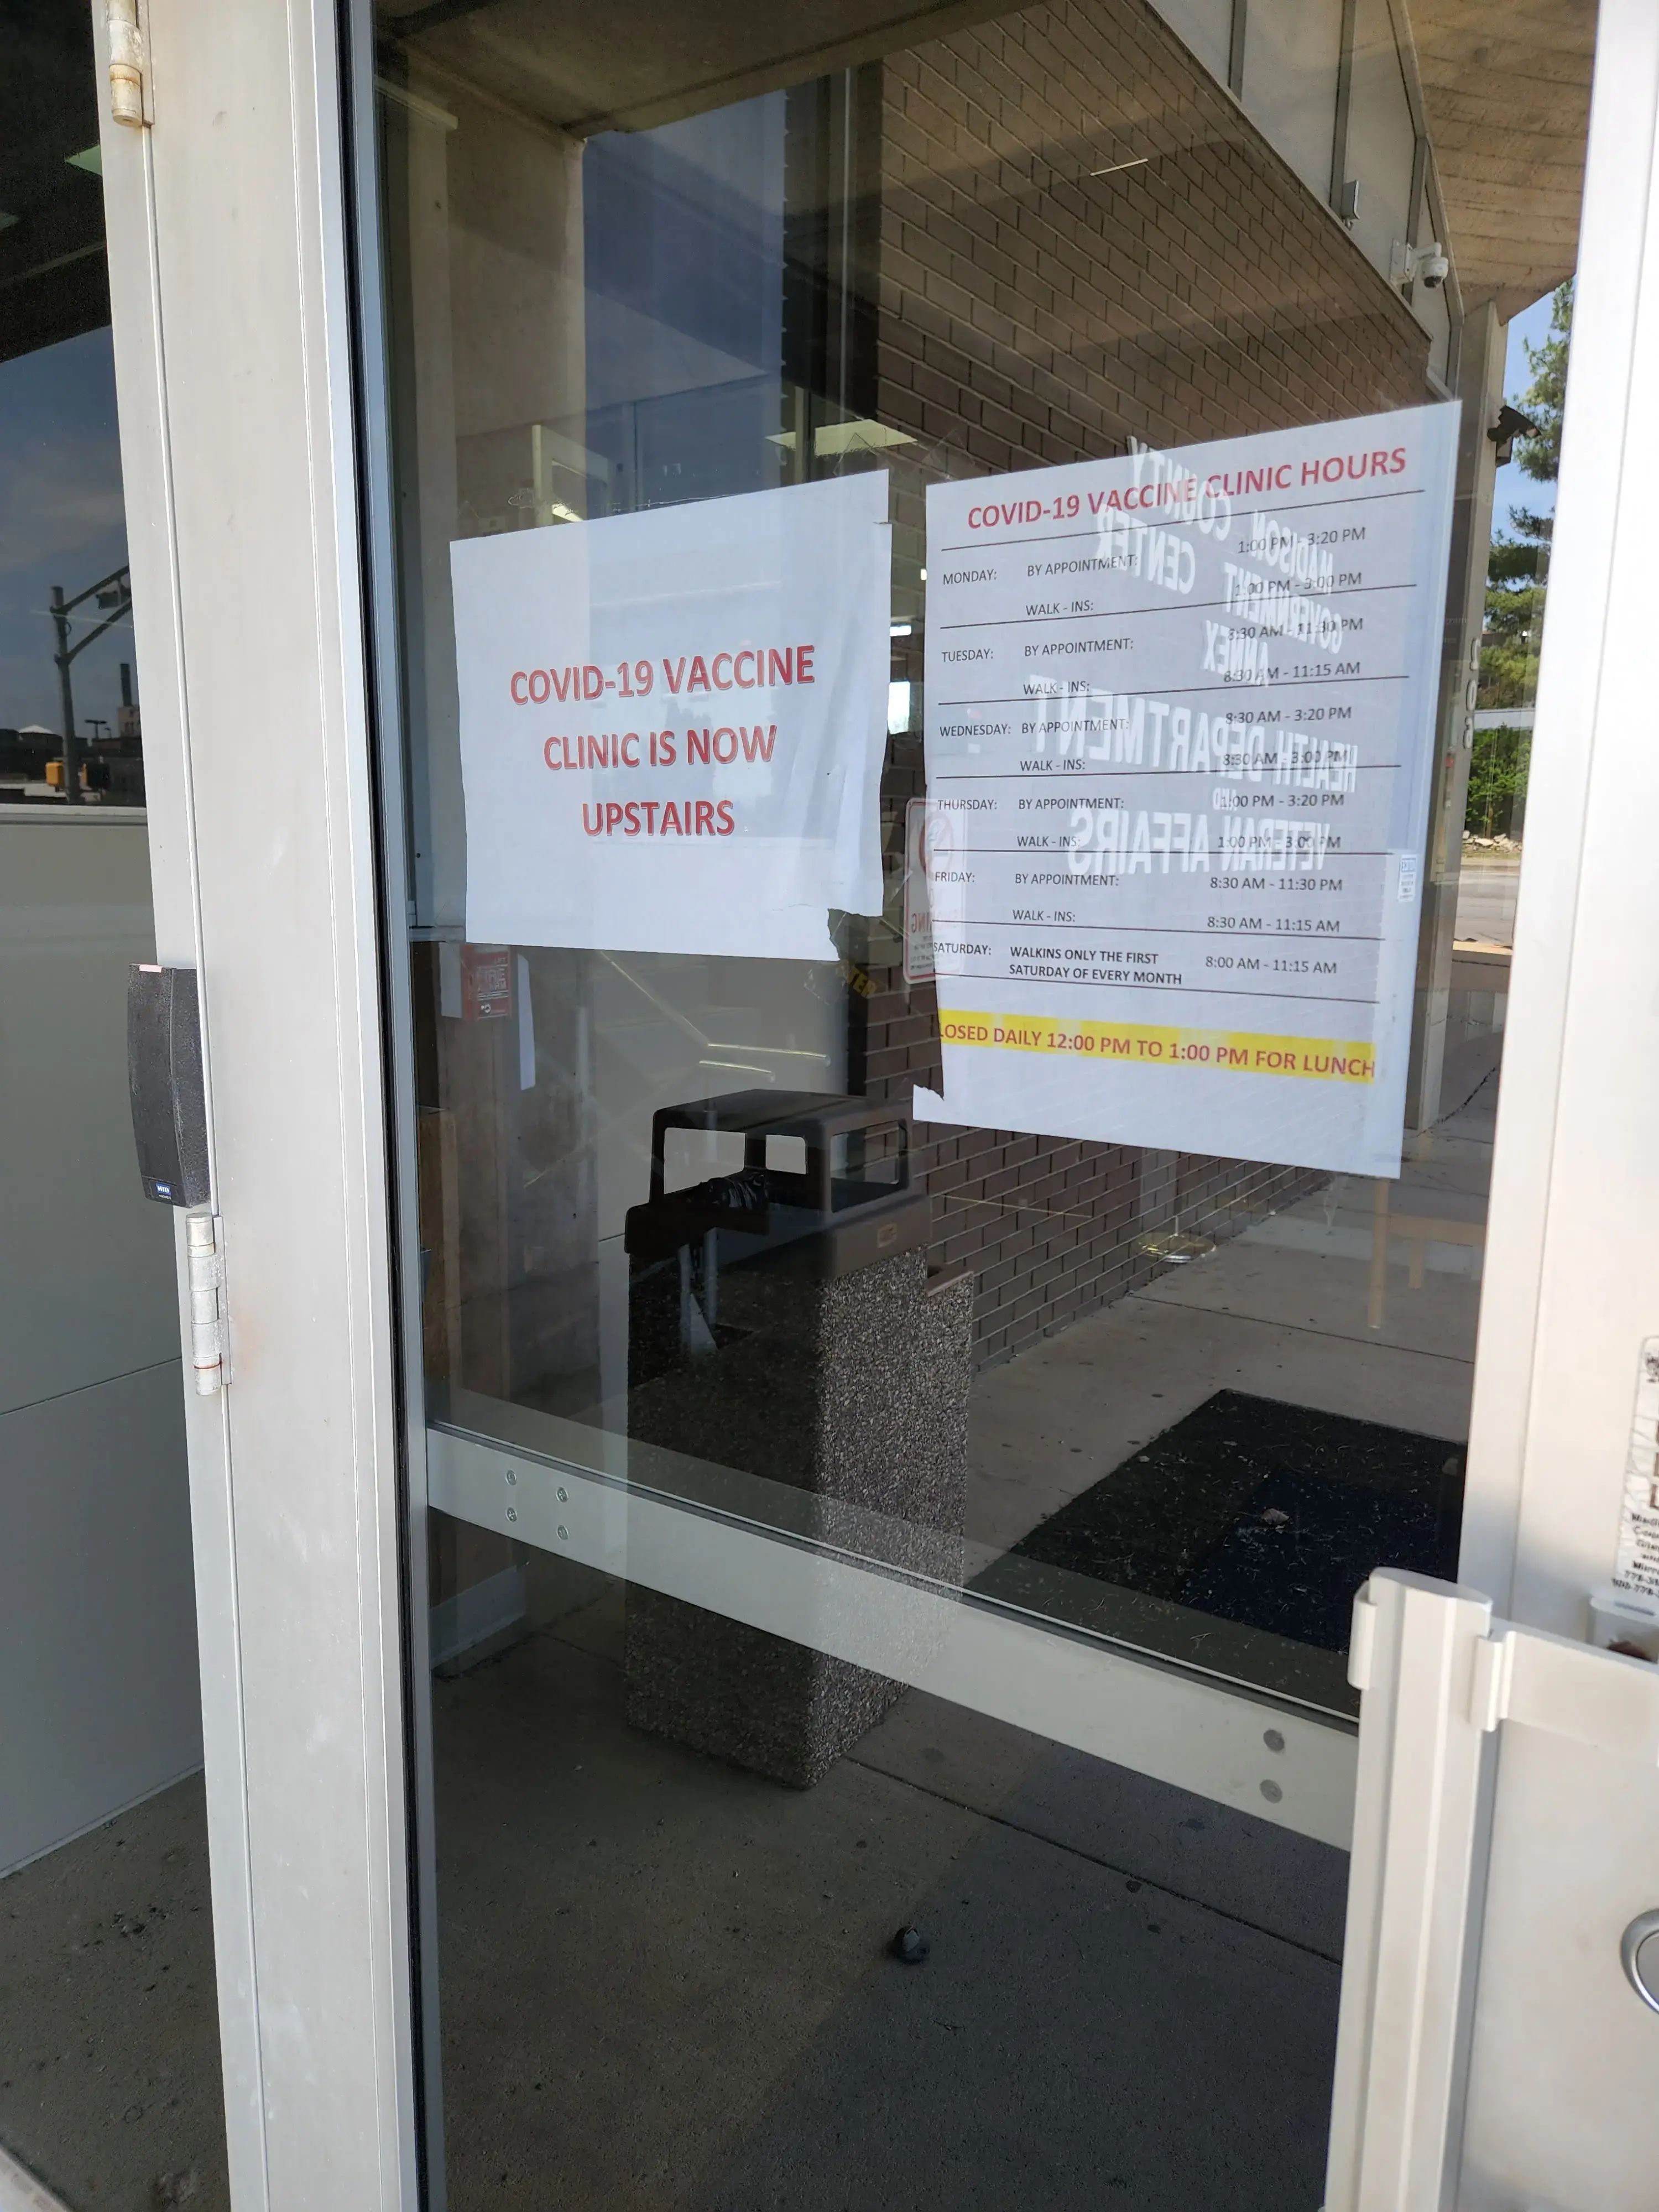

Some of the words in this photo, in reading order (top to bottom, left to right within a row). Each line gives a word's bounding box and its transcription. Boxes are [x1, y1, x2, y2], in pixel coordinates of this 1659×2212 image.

[968, 494, 1080, 529] COVID-19
[1087, 477, 1196, 514] VACCINE
[1205, 465, 1291, 498] CLINIC
[1301, 447, 1406, 486] HOURS
[943, 569, 997, 585] MONDAY:
[1027, 564, 1042, 577] BY
[1045, 554, 1138, 576] APPOINTMENT:
[1239, 538, 1266, 554] 1:00
[1271, 535, 1293, 551] PM
[1307, 531, 1338, 546] 3:20
[1343, 526, 1366, 542] PM
[1026, 602, 1060, 615] WALK
[1071, 600, 1094, 613] INS:
[1269, 580, 1290, 593] PM
[1305, 575, 1334, 591] 3:00
[1339, 572, 1362, 587] PM
[941, 648, 994, 662] TUESDAY:
[1025, 644, 1040, 656] BY
[1042, 638, 1134, 655] APPOINTMENT:
[1259, 624, 1283, 638] AM
[1341, 618, 1363, 632] PM
[510, 659, 654, 705] COVID-19
[662, 645, 815, 694] VACCINE
[1023, 682, 1057, 696] WALK
[1067, 681, 1090, 693] INS:
[1293, 664, 1331, 678] 11:15
[1335, 662, 1360, 675] AM
[940, 723, 1011, 737] WEDNESDAY:
[1021, 722, 1036, 734] BY
[1039, 719, 1130, 733] APPOINTMENT:
[1225, 712, 1254, 724] 8:30
[1257, 709, 1281, 722] AM
[1295, 708, 1325, 722] 3:20
[1329, 706, 1352, 719] PM
[543, 732, 640, 770] CLINIC
[650, 731, 676, 766] IS
[687, 724, 778, 765] NOW
[1020, 759, 1053, 771] WALK
[1063, 759, 1086, 770] INS:
[1223, 753, 1250, 766] 8:30
[1253, 752, 1277, 765] AM
[582, 799, 735, 837] UPSTAIRS
[937, 799, 998, 811] THURSDAY:
[1019, 799, 1033, 809] BY
[1035, 797, 1124, 809] APPOINTMENT:
[1219, 795, 1248, 808] 1:00
[1252, 795, 1274, 807] PM
[1287, 794, 1318, 806] 3:20
[1323, 794, 1345, 806] PM
[1017, 836, 1048, 847] WALK
[935, 872, 975, 883] FRIDAY:
[1015, 873, 1029, 885] BY
[1031, 874, 1119, 886] APPOINTMENT:
[1210, 877, 1239, 889] 8:30
[1241, 877, 1265, 890] AM
[1279, 878, 1316, 891] 11:30
[1319, 879, 1343, 891] PM
[1013, 909, 1044, 922] WALK
[1054, 910, 1076, 922] INS:
[1207, 917, 1236, 929] 8:30
[1239, 917, 1262, 930] AM
[1276, 919, 1312, 932] 11:15
[1316, 920, 1340, 933] AM
[933, 942, 992, 956] SATURDAY:
[1010, 946, 1062, 961] WALKINS
[1065, 948, 1097, 962] ONLY
[1099, 950, 1123, 963] THE
[1126, 952, 1159, 965] FIRST
[1206, 956, 1234, 968] 8:00
[1236, 958, 1260, 971] AM
[1273, 959, 1309, 973] 11:15
[1313, 961, 1337, 974] AM
[1009, 963, 1070, 979] SATURDAY
[1072, 967, 1090, 979] OF
[1092, 968, 1131, 983] EVERY
[1133, 971, 1182, 984] MONTH
[940, 1022, 989, 1042] OSED
[993, 1026, 1041, 1047] DAILY
[1046, 1030, 1095, 1052] 12:00
[1100, 1037, 1131, 1056] PM
[1136, 1040, 1162, 1058] TO
[1169, 1042, 1210, 1062] 1:00
[1215, 1046, 1249, 1066] PM
[1255, 1050, 1296, 1071] FOR
[1302, 1055, 1376, 1078] LUNCH
[157, 1185, 170, 1193] HID
